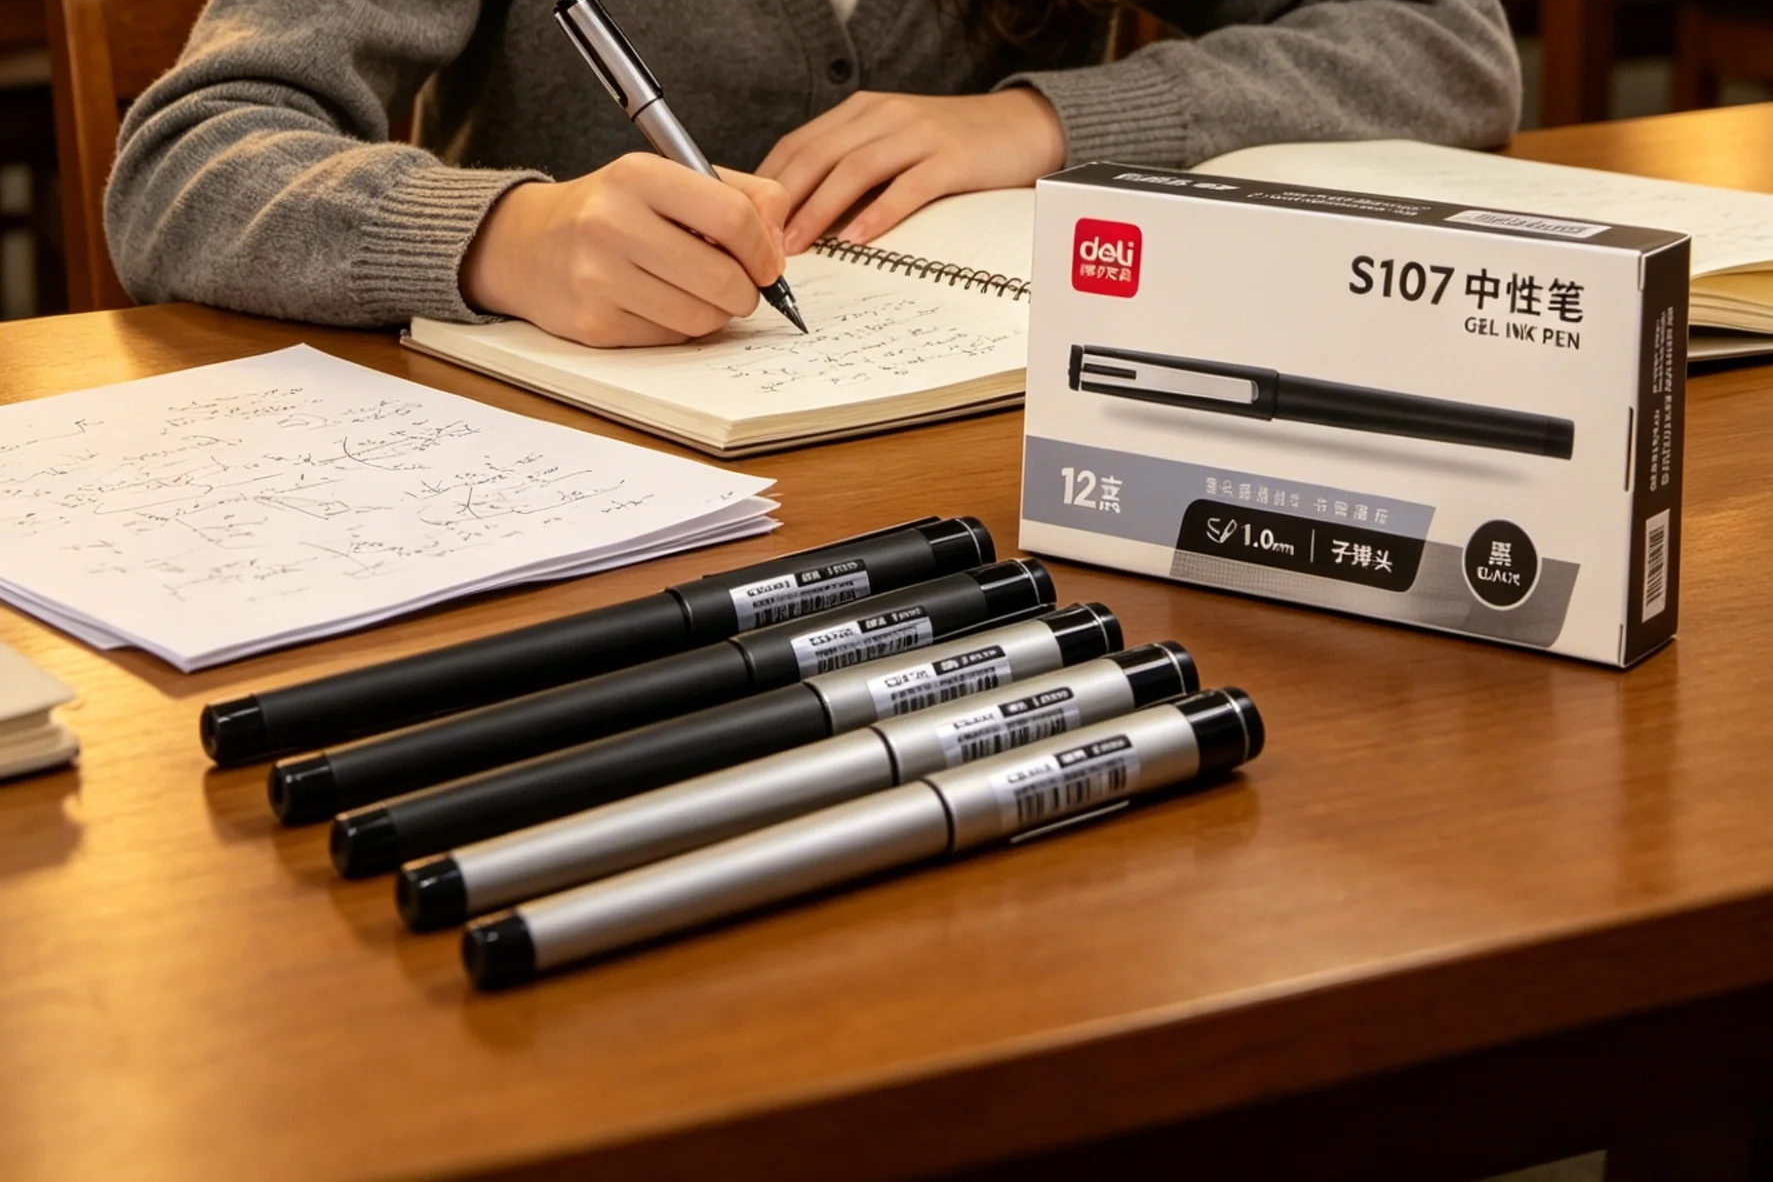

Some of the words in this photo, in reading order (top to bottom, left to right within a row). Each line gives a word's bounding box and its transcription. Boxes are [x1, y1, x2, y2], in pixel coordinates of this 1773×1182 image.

[1079, 236, 1135, 267] deli
[1349, 255, 1455, 305] S107
[1464, 268, 1585, 323] 中性笔
[1464, 317, 1499, 337] GEL
[1542, 328, 1581, 350] PEN
